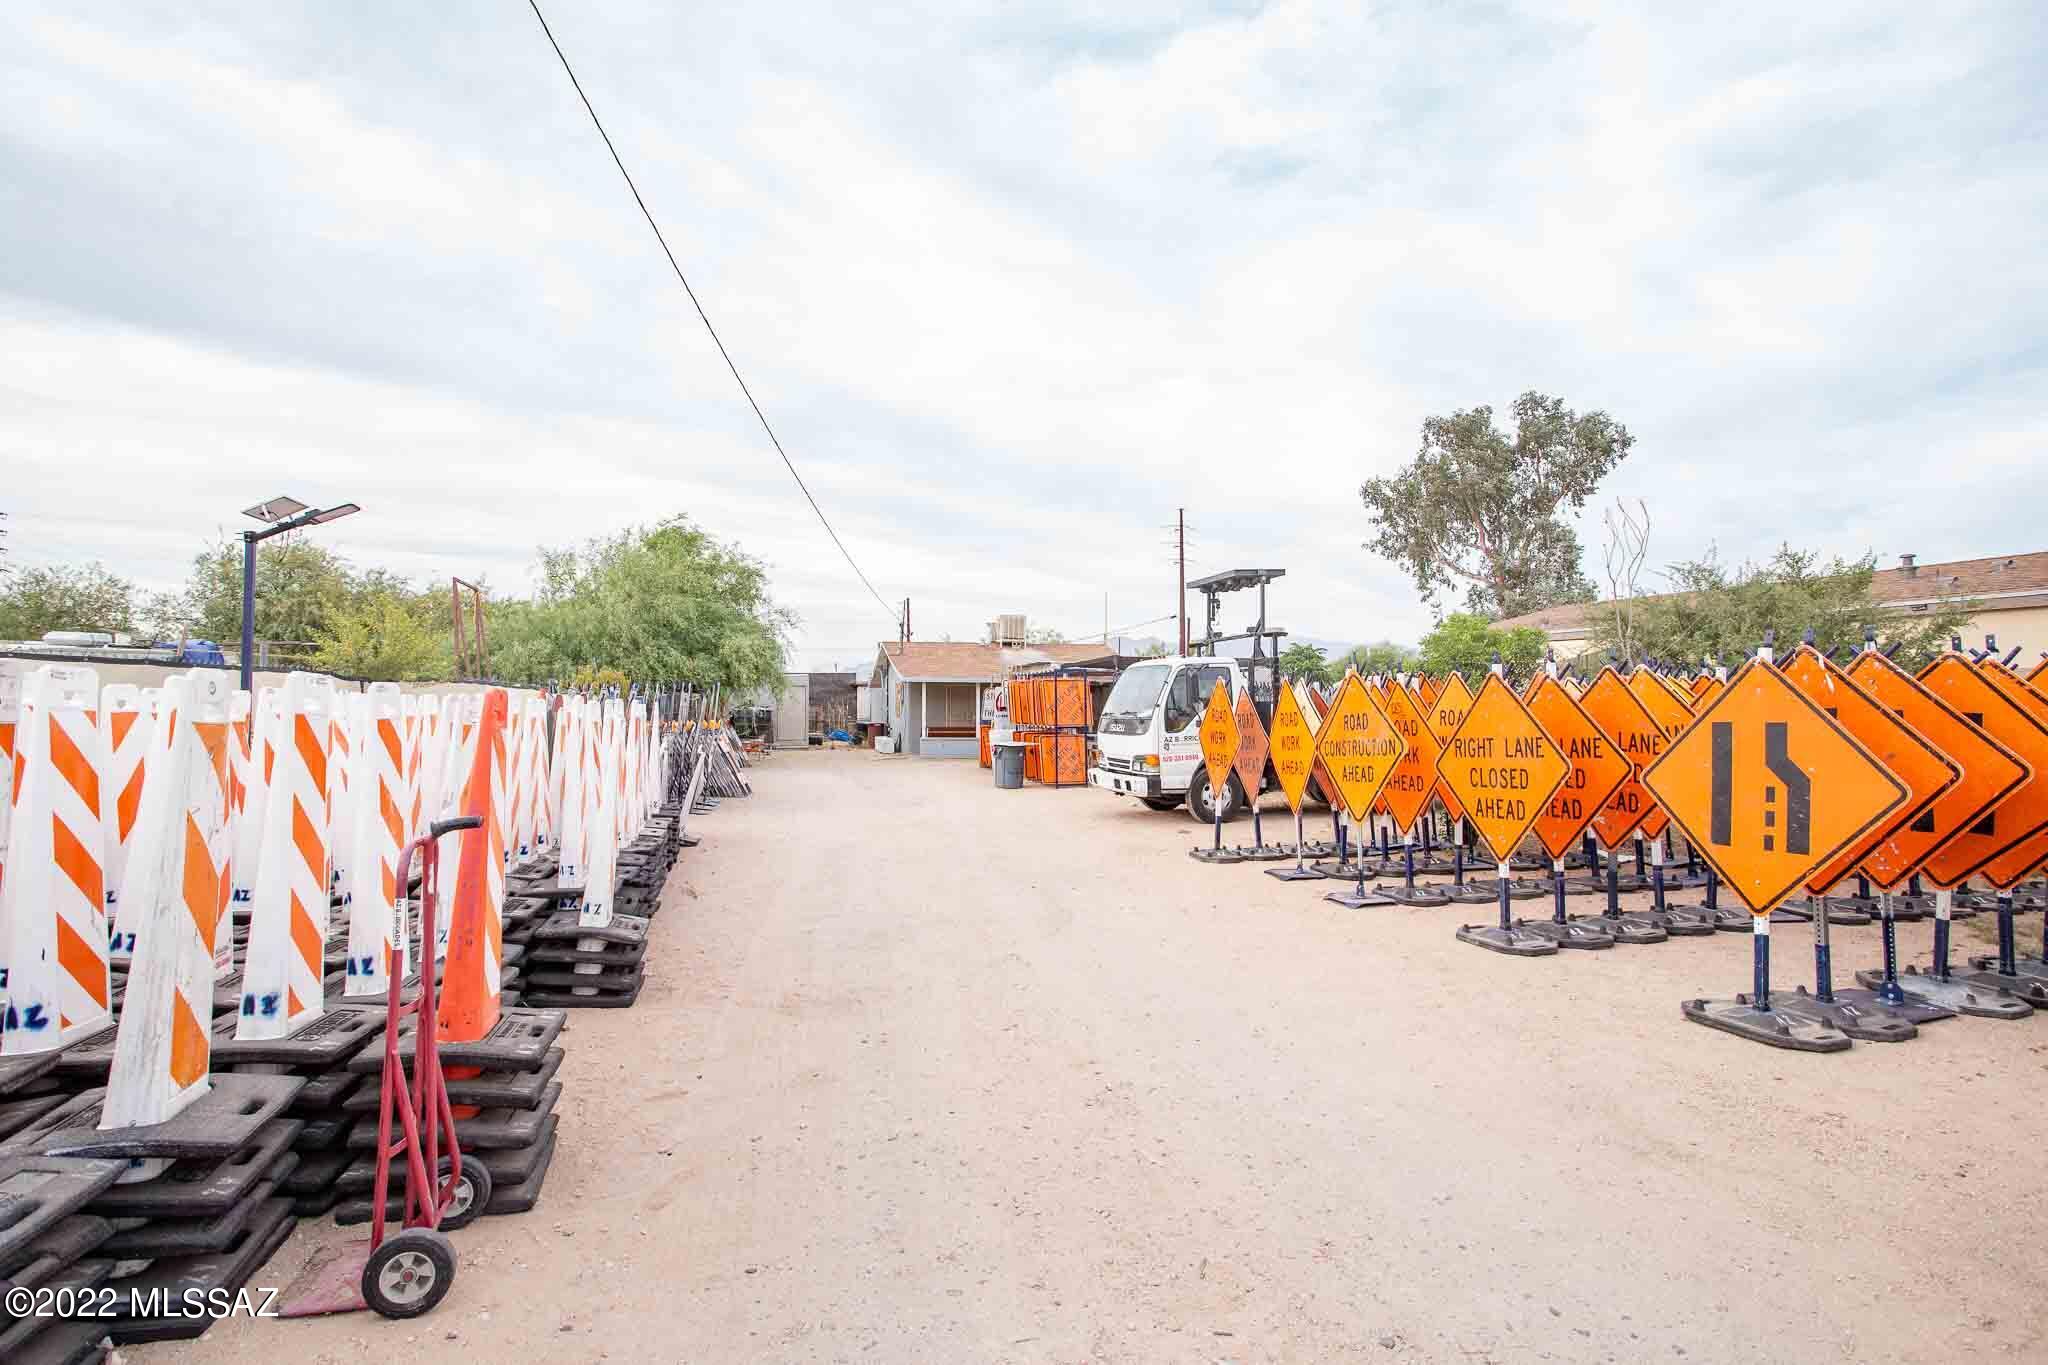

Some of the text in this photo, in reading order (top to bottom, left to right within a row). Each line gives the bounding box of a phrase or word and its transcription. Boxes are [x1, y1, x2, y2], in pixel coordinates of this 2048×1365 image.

[1237, 712, 1255, 728] ROAD
[1280, 711, 1298, 727] ROAD
[1343, 712, 1369, 731] ROAD
[1440, 709, 1463, 726] ROA
[1210, 730, 1227, 744] WORK
[1394, 719, 1418, 737] OAD
[1281, 735, 1300, 752] WORK
[1324, 738, 1396, 757] CONSTRUCTION
[1454, 737, 1494, 758] RIGHT
[1504, 736, 1545, 759] LANE
[1618, 731, 1661, 755] LANE
[1281, 759, 1304, 775] AHEAD
[1342, 765, 1374, 783] AHEAD
[1469, 767, 1529, 790] CLOSED
[1475, 797, 1526, 821] AHEAD
[1545, 797, 1583, 820] EAD
[105, 890, 118, 904] Z
[233, 888, 251, 902] AZ
[347, 955, 375, 976] AZ
[242, 992, 281, 1018] AZ
[4, 1002, 49, 1032] AZ
